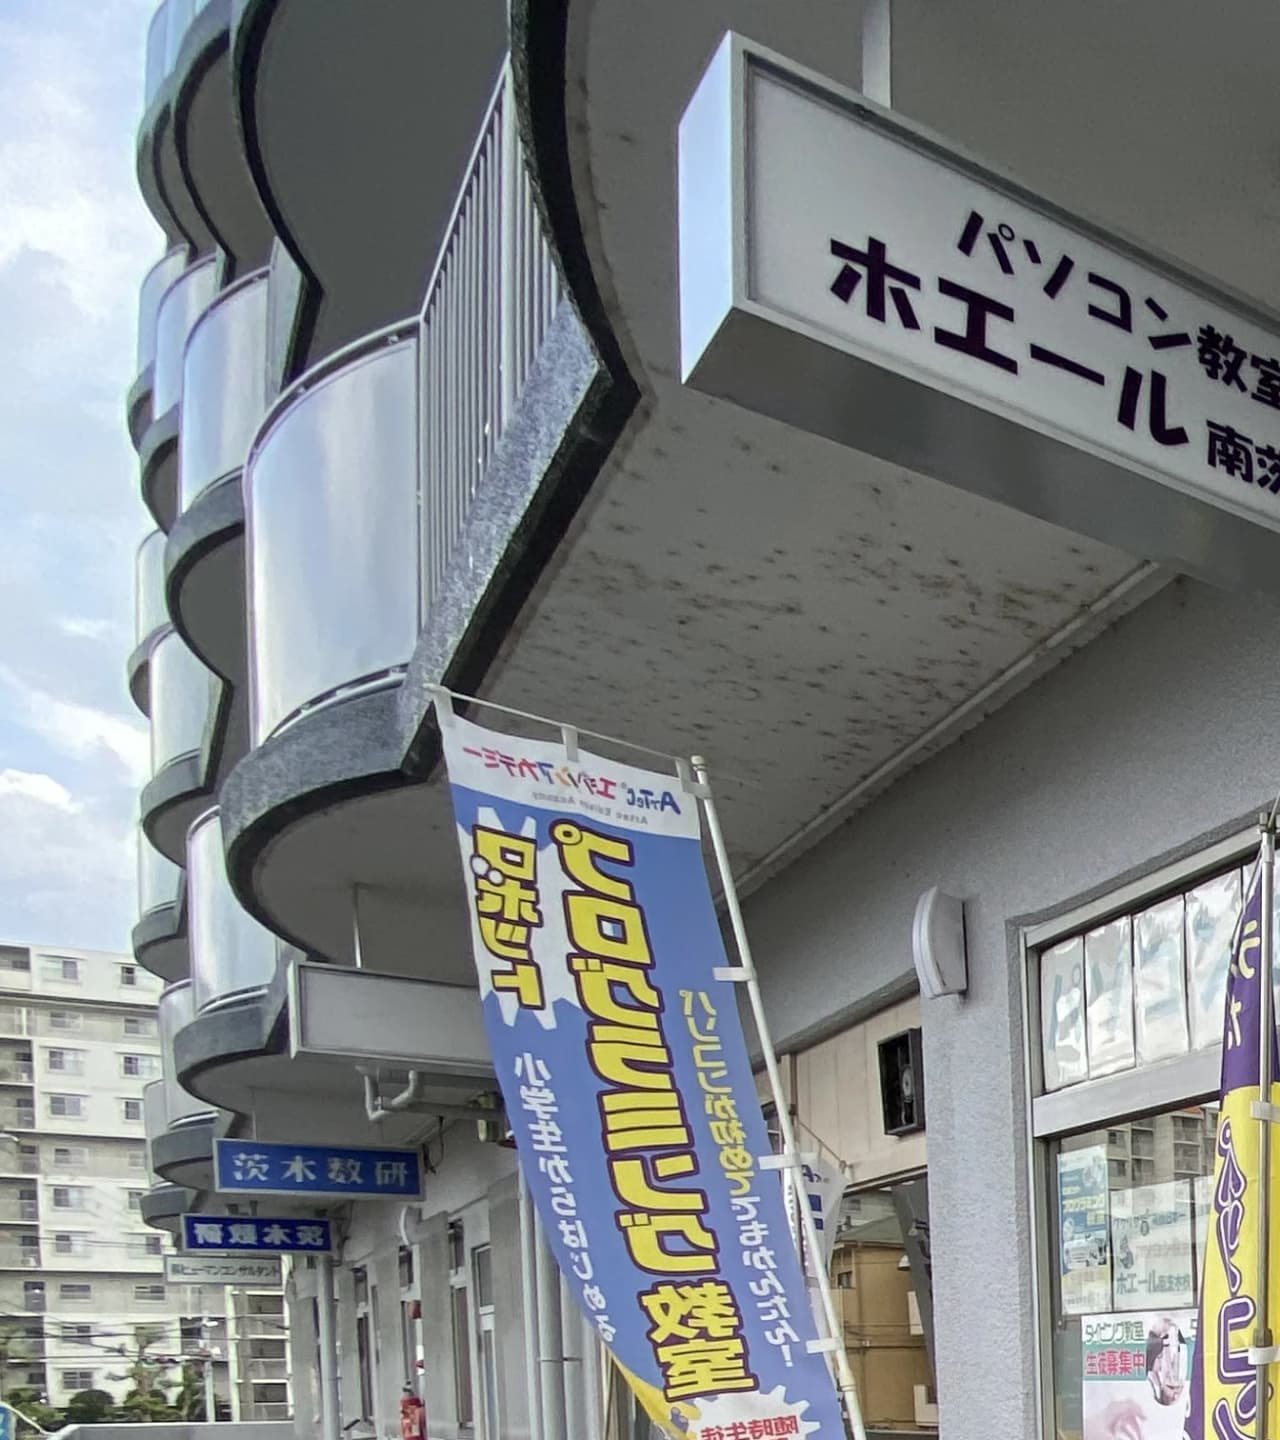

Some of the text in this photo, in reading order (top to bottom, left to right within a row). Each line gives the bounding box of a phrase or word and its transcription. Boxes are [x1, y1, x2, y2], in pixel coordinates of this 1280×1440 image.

[829, 236, 1190, 446] ホエール
[231, 1153, 408, 1185] 茨木数研
[1085, 1349, 1146, 1376] 生徒募集中
